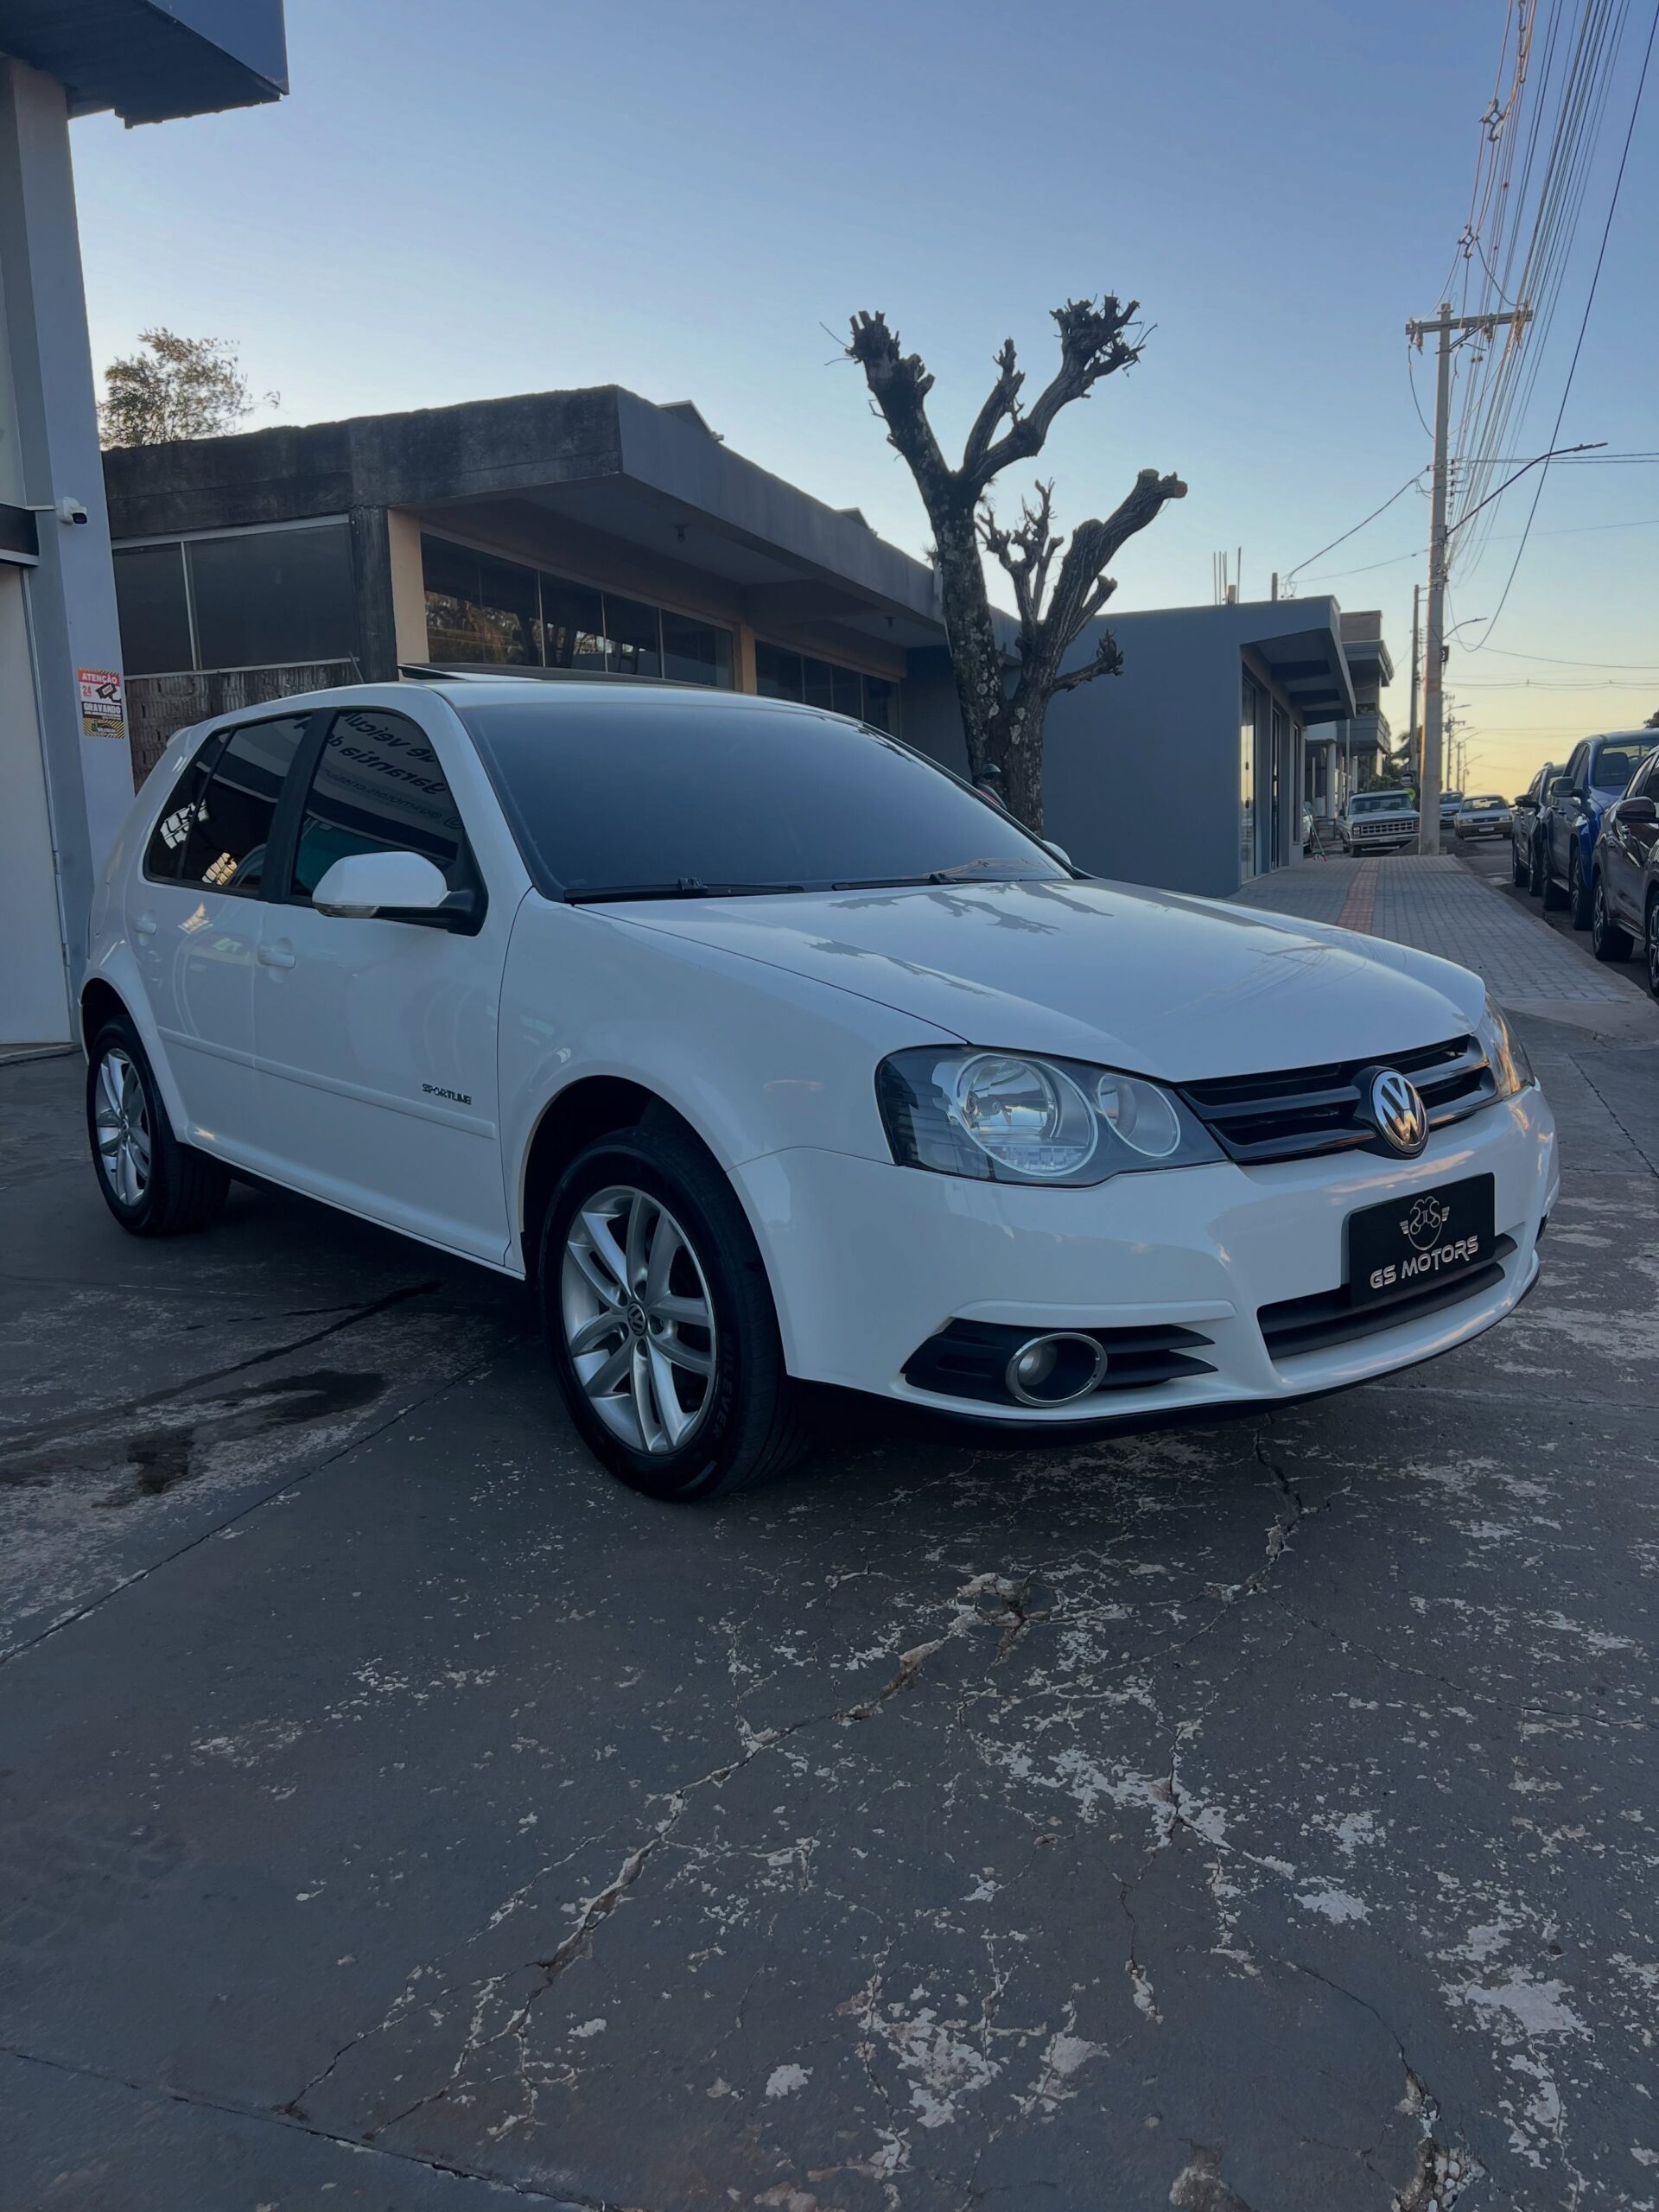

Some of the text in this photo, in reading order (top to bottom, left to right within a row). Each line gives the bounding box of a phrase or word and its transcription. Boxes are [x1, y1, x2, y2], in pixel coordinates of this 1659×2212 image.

[82, 673, 118, 685] ATENÇÃO
[82, 685, 92, 695] 24
[83, 702, 121, 715] GRAVANDO
[422, 1084, 472, 1105] SPORTLINE
[1372, 1071, 1427, 1154] VW
[1370, 1235, 1479, 1289] GS MOTORS
